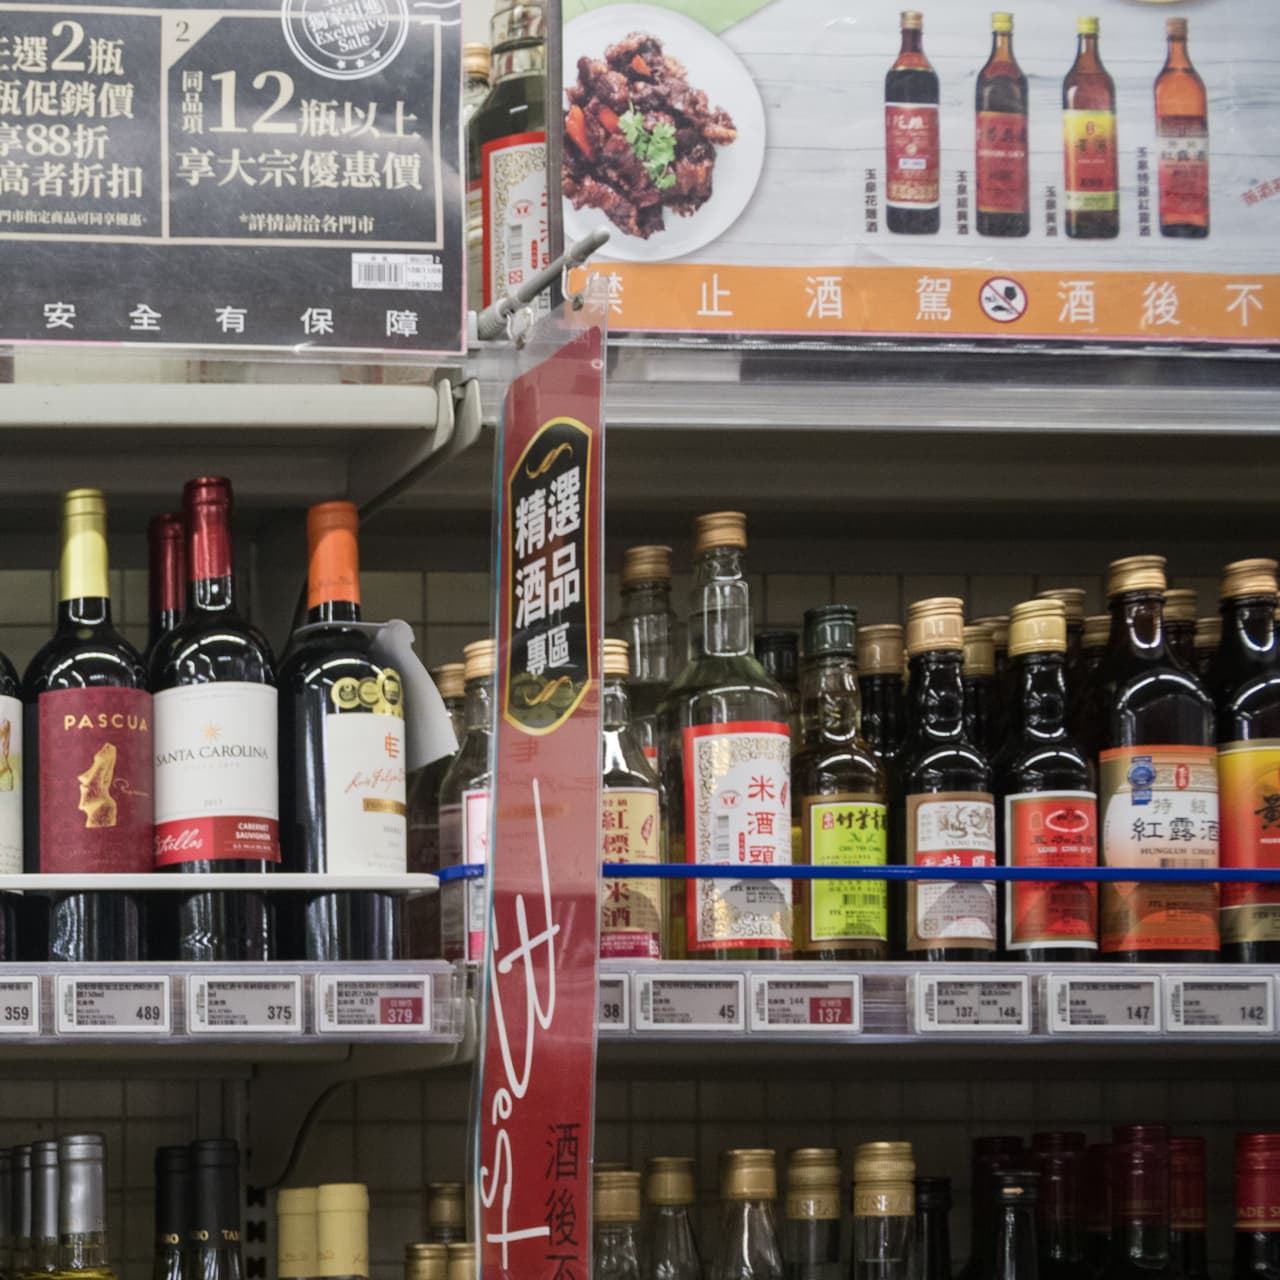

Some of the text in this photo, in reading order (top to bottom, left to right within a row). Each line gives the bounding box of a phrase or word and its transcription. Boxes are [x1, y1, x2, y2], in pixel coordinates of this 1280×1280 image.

[176, 21, 190, 42] 2
[314, 17, 385, 46] Exclusive
[340, 34, 370, 52] Sale
[182, 70, 203, 134] 同品項
[209, 70, 421, 138] 12瓶以上
[176, 148, 422, 190] 享大宗優惠價
[515, 466, 581, 559] 精選
[515, 543, 581, 629] 酒品
[527, 622, 571, 676] 專區
[63, 713, 149, 732] PASCUA
[155, 742, 269, 768] SANTA CAROLINA
[1131, 817, 1219, 842] 紅露酒
[136, 1005, 161, 1022] 489
[604, 1004, 621, 1021] 38
[1127, 1006, 1150, 1020] 147
